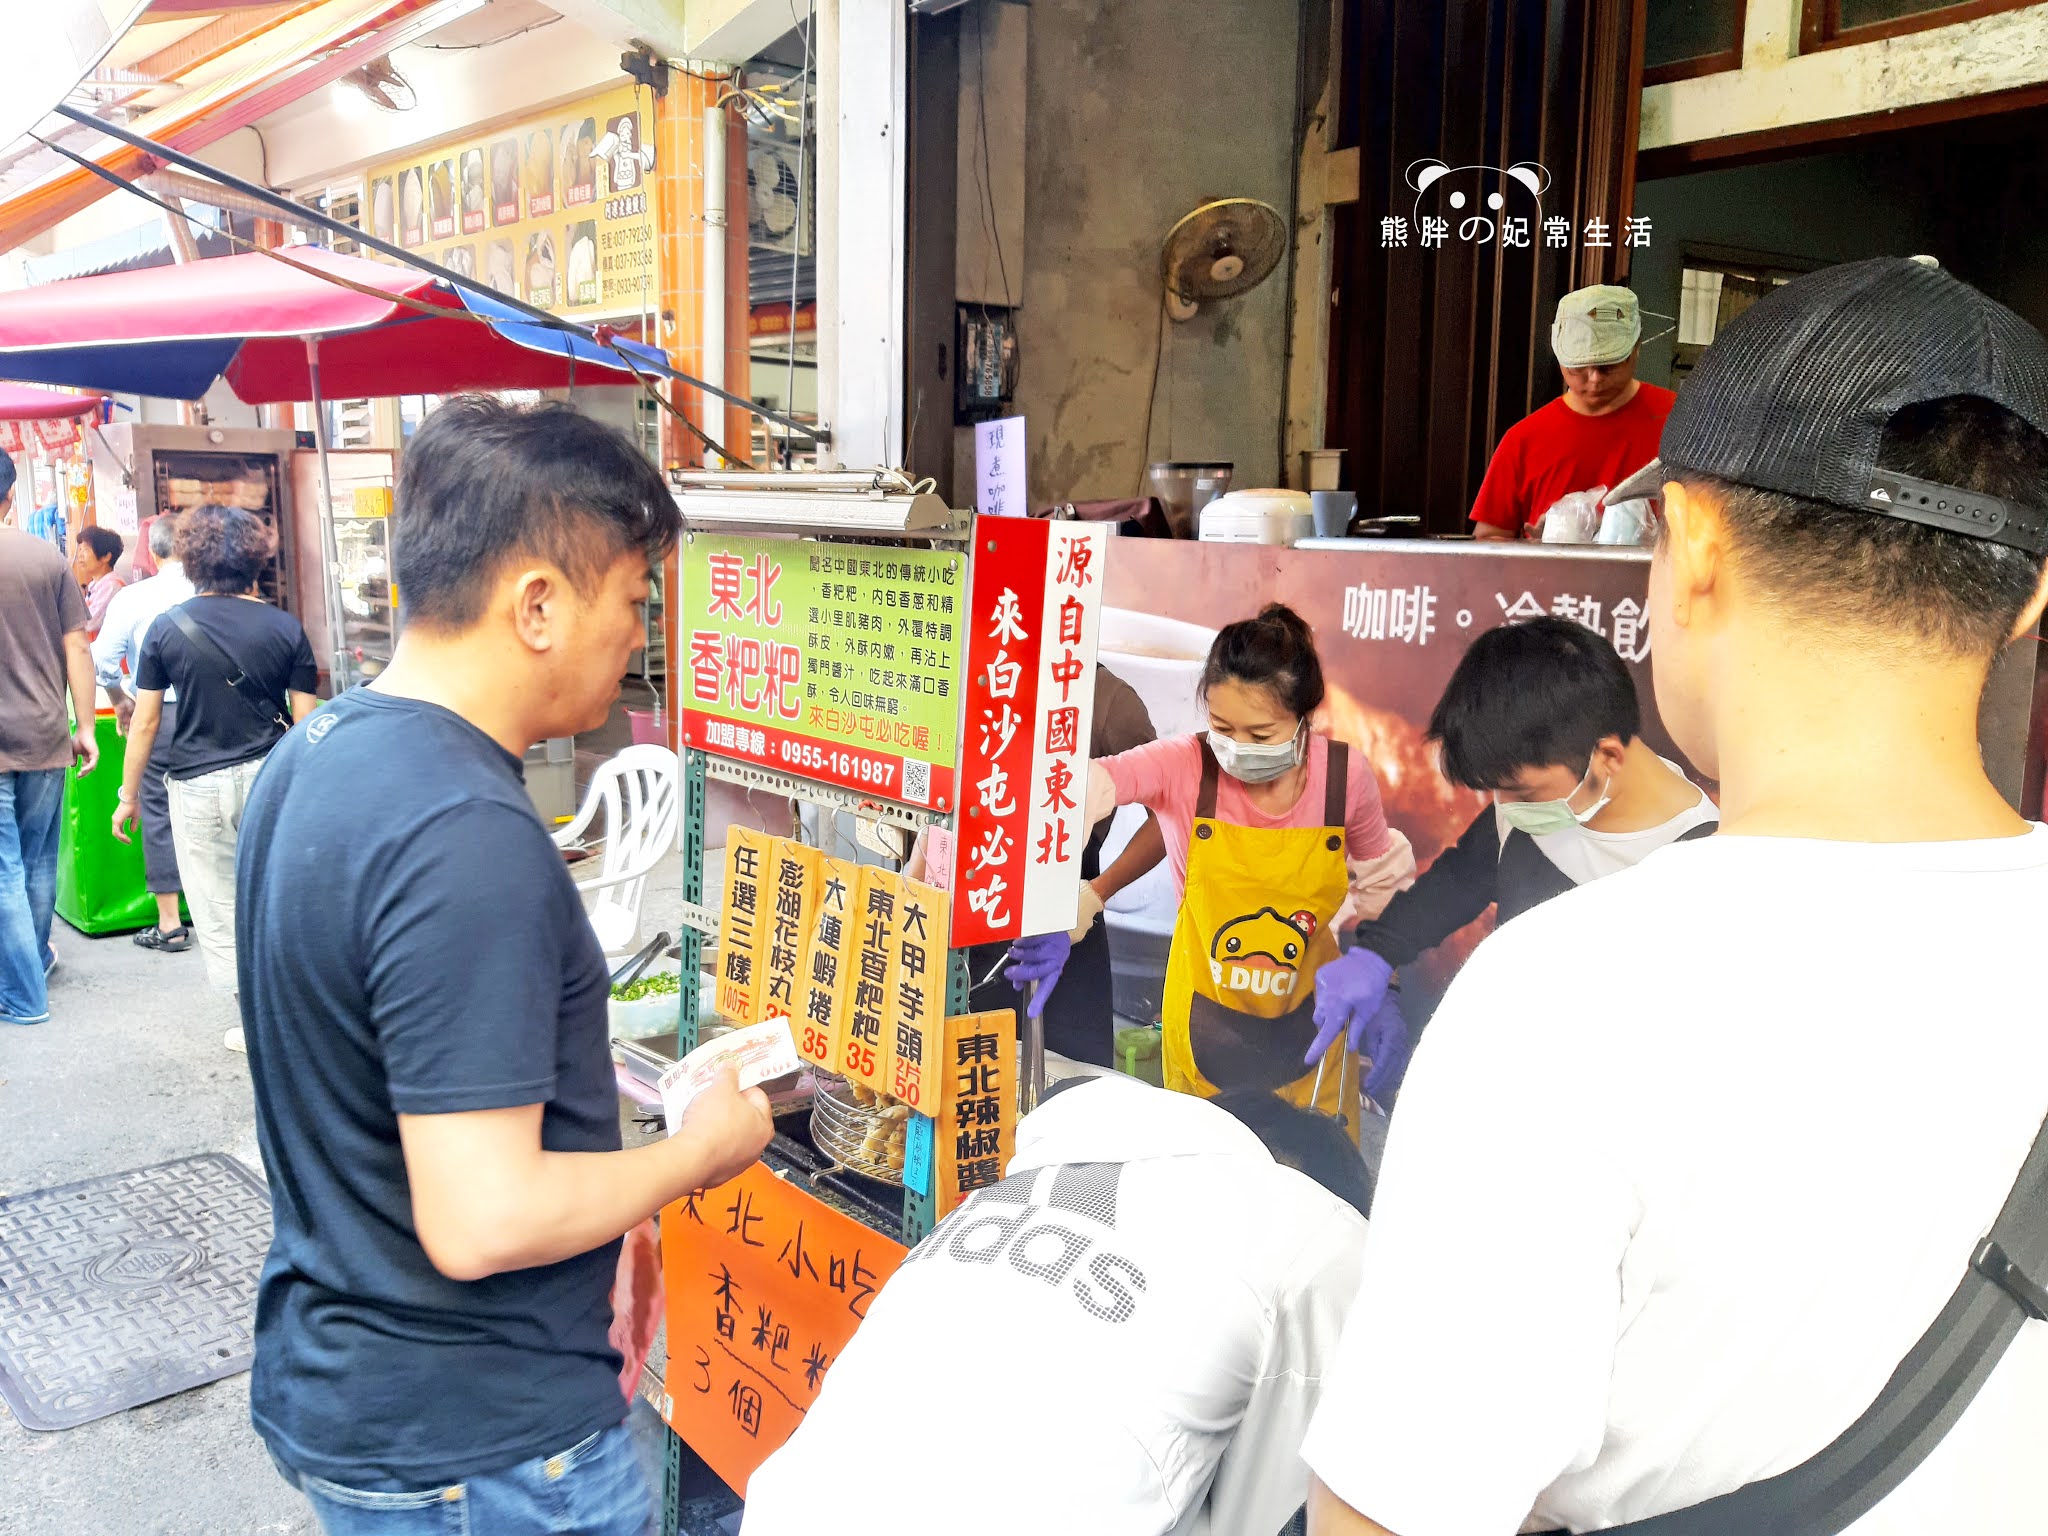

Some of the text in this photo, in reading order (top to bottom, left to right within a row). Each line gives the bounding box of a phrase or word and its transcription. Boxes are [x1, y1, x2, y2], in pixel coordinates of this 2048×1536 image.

[708, 550, 783, 627] 東北
[690, 630, 802, 722] 香粑粑
[1036, 536, 1093, 865] 源自中國東北
[968, 586, 1029, 929] 來白沙屯必吃
[725, 845, 759, 987] 任選三樣
[769, 858, 804, 1006] 澎湖花枝丸
[807, 877, 846, 1027] 大連蝦捲
[851, 887, 895, 1047] 東北香粑粑
[896, 903, 928, 1066] 大甲芋頭
[722, 983, 750, 1019] 100元
[803, 1026, 828, 1060] 35
[846, 1042, 876, 1077] 35
[897, 1057, 921, 1085] 2片
[894, 1078, 921, 1107] 50
[956, 1033, 1001, 1192] 東北辣椒醬
